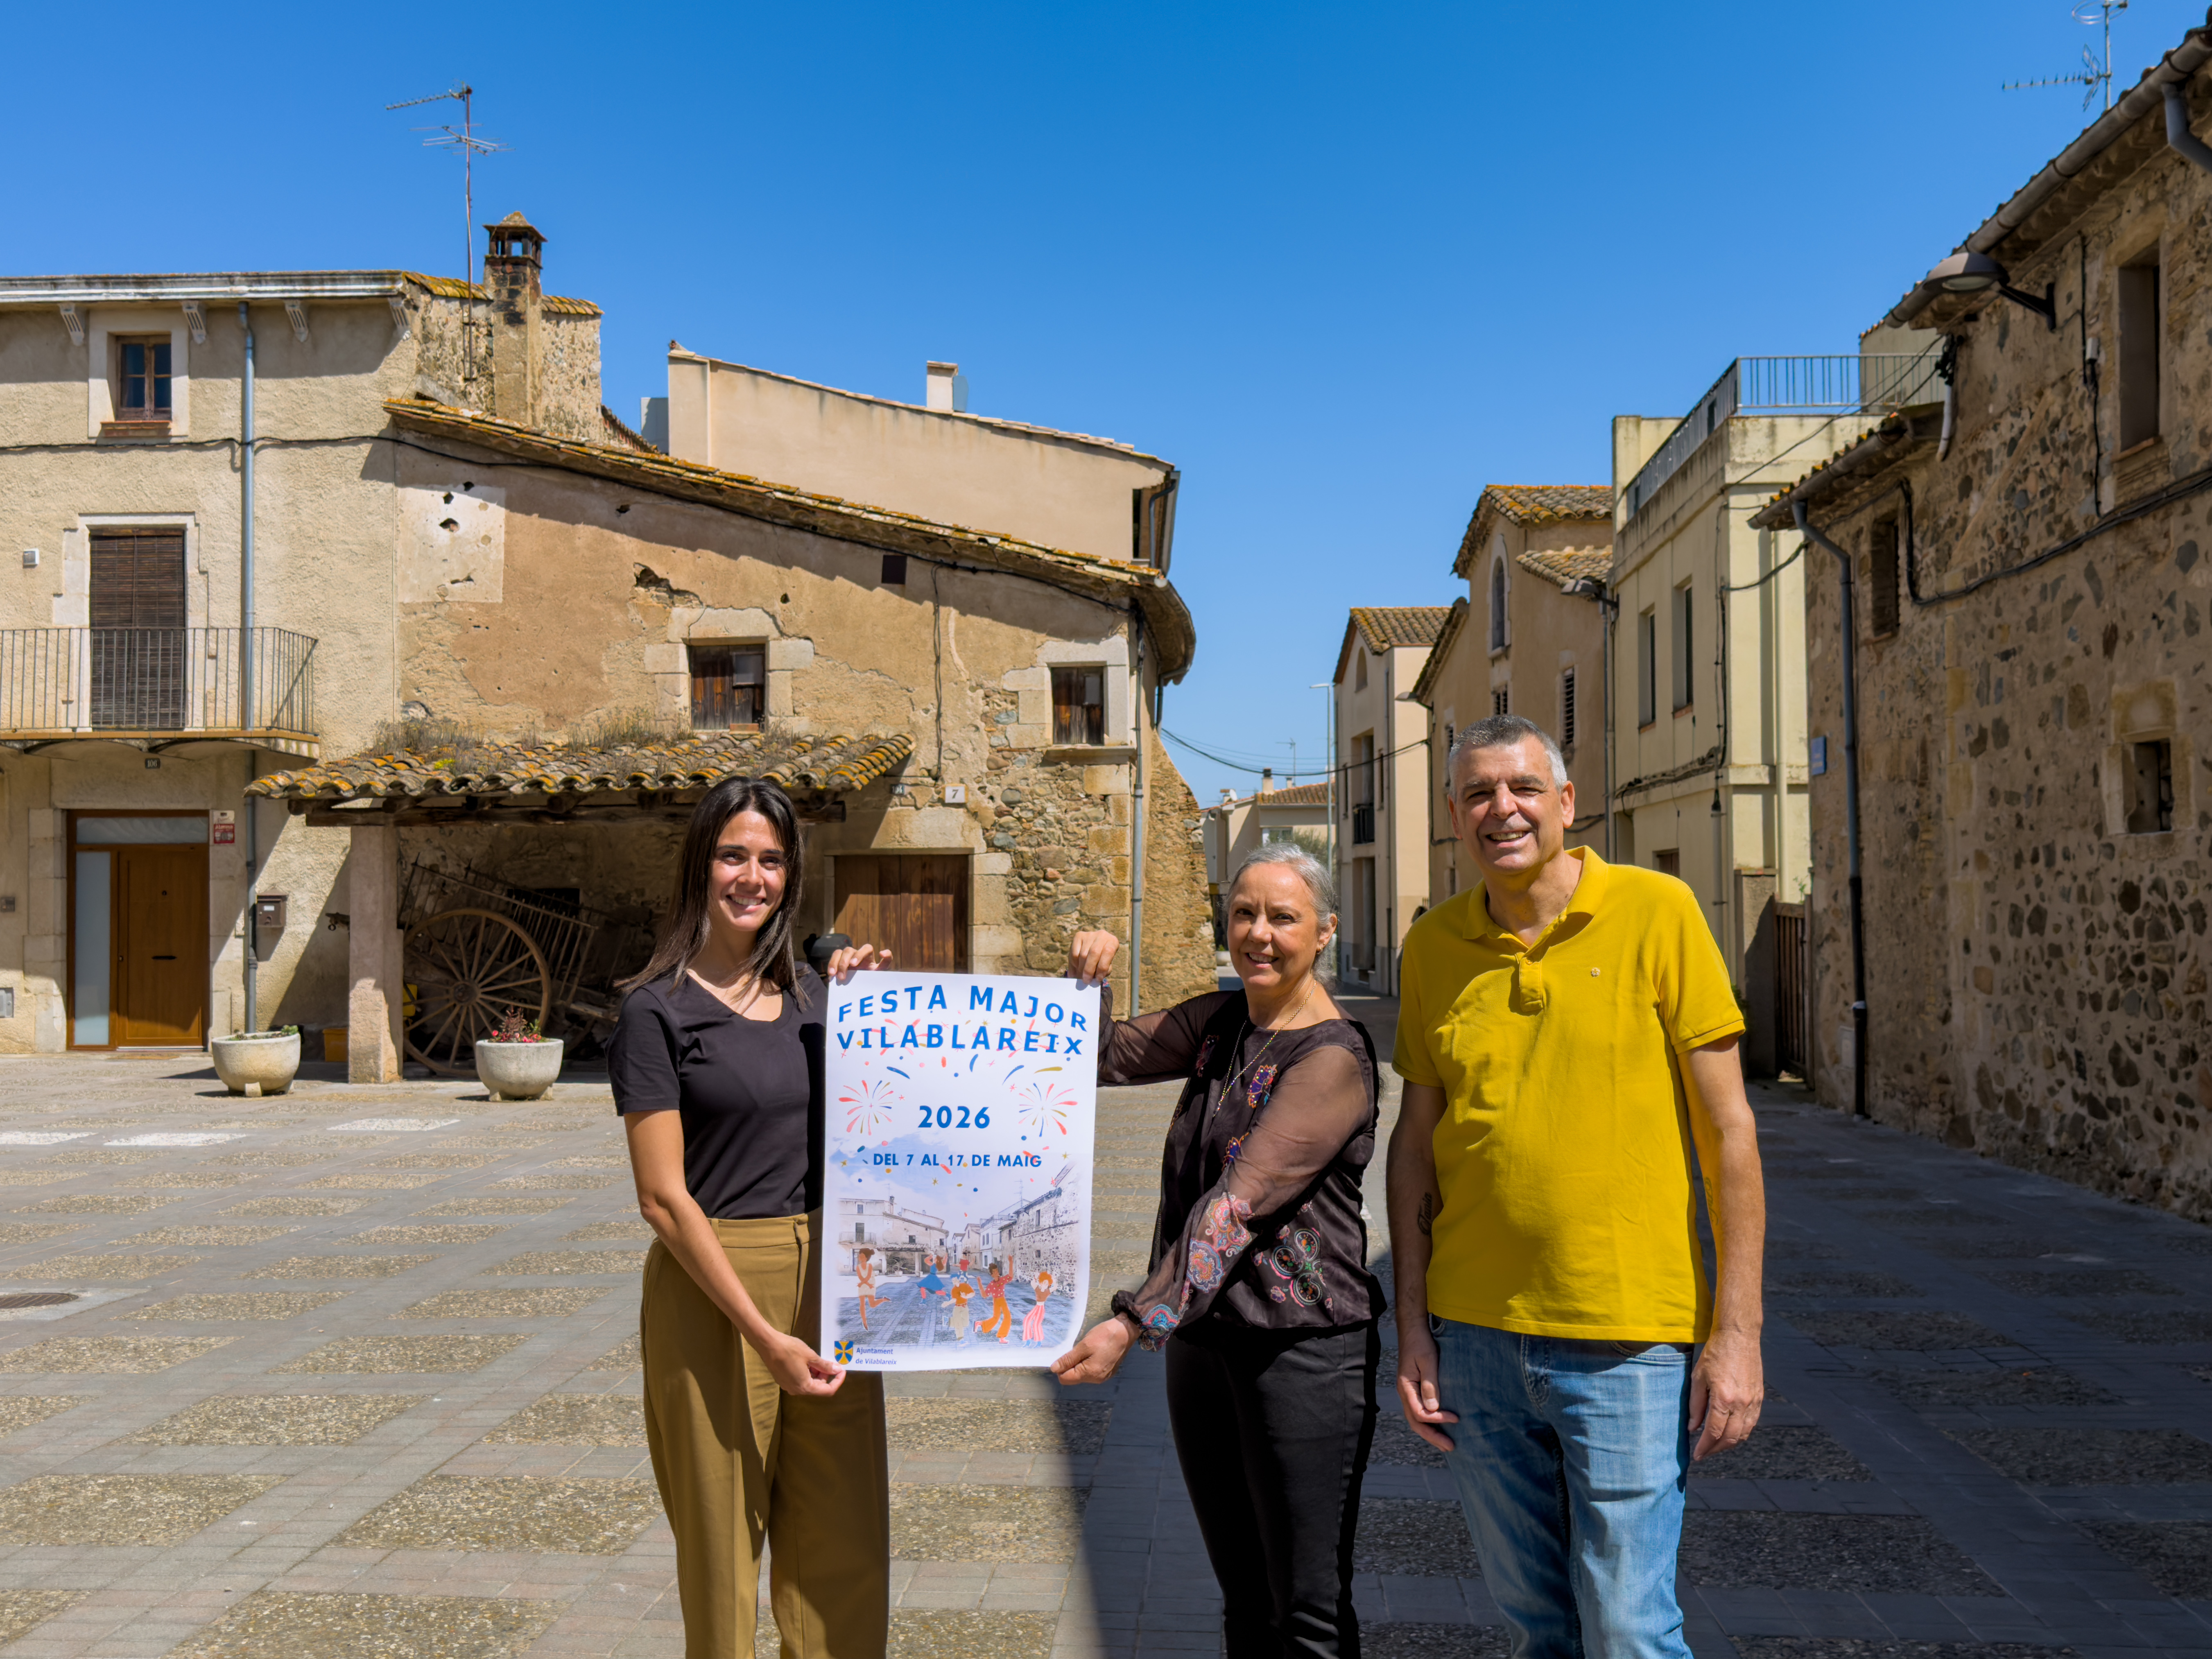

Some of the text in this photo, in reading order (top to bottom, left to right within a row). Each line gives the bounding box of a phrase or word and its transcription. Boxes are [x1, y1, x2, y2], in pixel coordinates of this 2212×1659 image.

[952, 789, 959, 799] 7
[839, 985, 1088, 1032] FESTA MAJOR
[837, 1024, 1083, 1055] VILABLAREIX
[918, 1105, 990, 1129] 2026
[873, 1153, 1042, 1167] DEL 7 AL 17 DE MAIG
